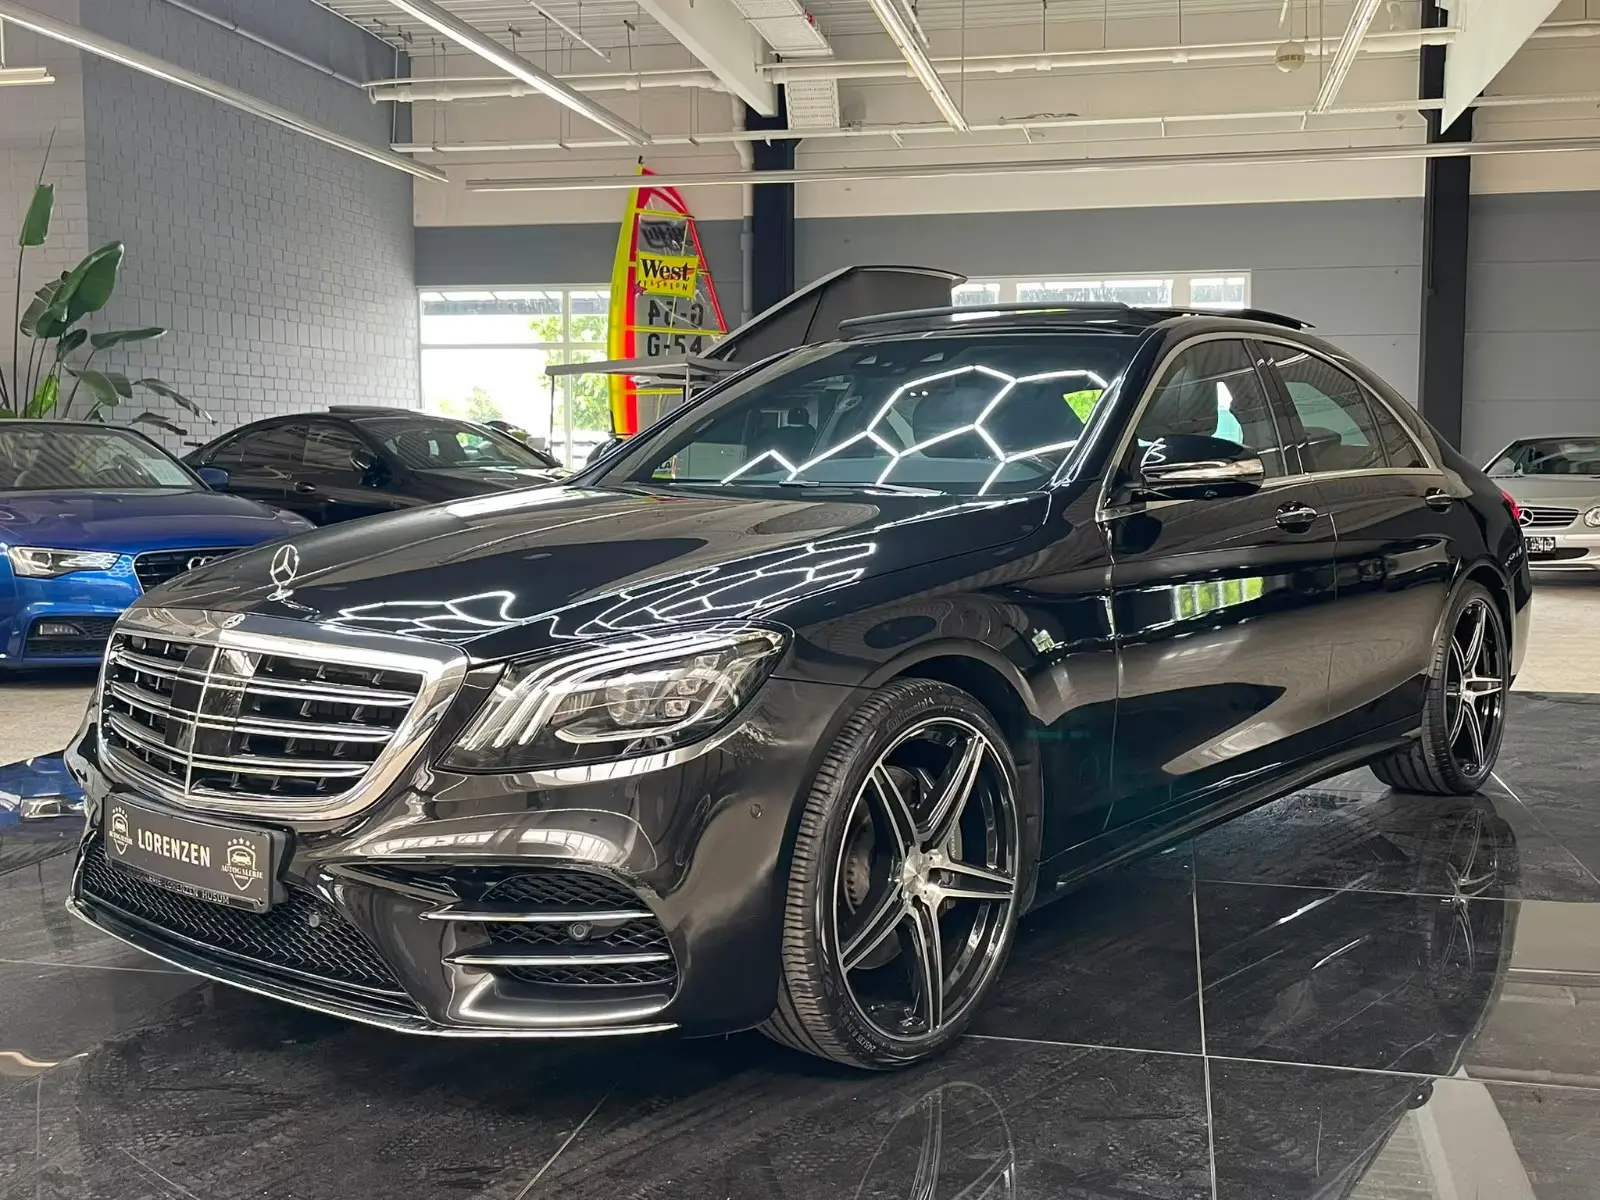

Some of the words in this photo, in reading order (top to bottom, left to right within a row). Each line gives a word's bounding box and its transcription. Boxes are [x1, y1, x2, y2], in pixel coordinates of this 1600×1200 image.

[641, 259, 690, 282] West
[647, 333, 702, 357] G-54
[137, 828, 211, 867] LORENZEN
[221, 864, 264, 879] AUTOGALERIE
[202, 891, 231, 904] HUSUM
